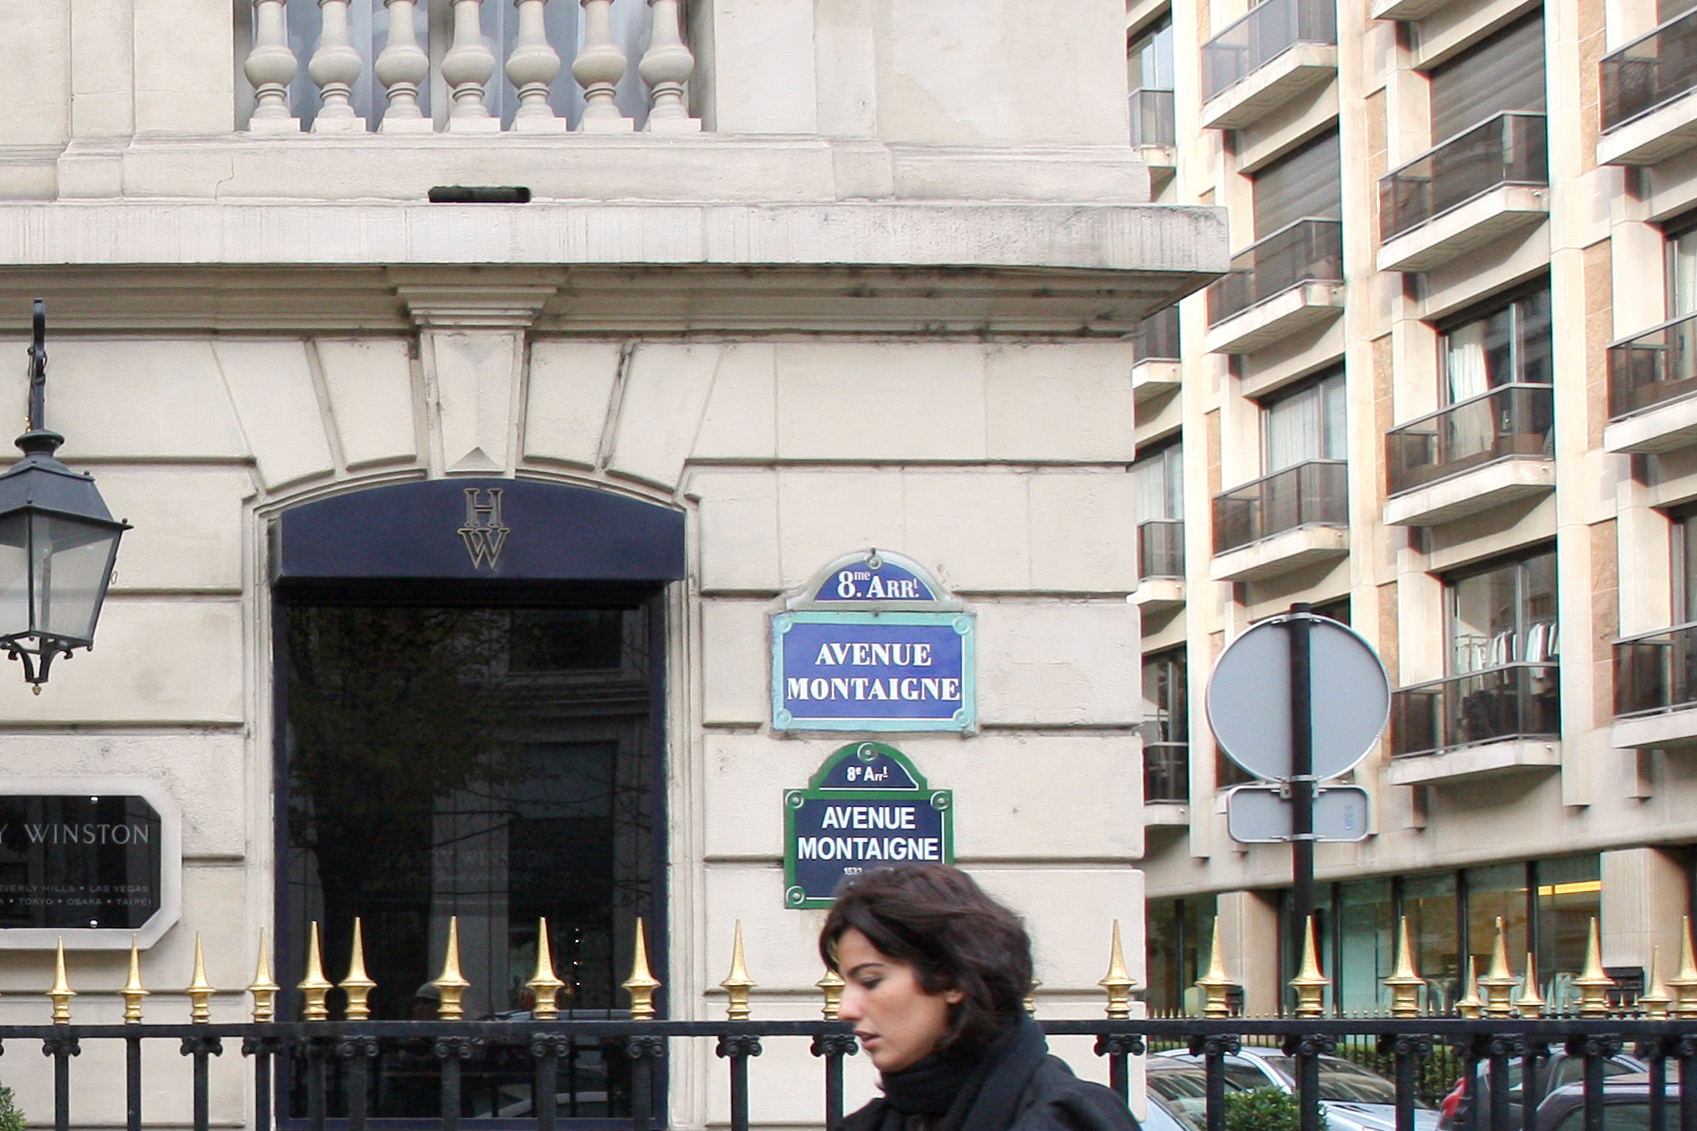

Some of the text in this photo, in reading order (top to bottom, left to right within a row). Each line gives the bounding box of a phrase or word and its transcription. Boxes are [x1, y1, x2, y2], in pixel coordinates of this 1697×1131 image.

[463, 488, 503, 528] H
[457, 527, 510, 570] W
[815, 643, 932, 666] AVENUE
[787, 678, 960, 701] MONTAIGNE
[847, 766, 862, 781] 8e
[821, 806, 916, 829] AVENUE
[23, 823, 150, 844] WINSTON
[798, 837, 939, 860] MONTAIGNE
[43, 884, 76, 893] HILLS
[89, 885, 111, 893] LAS
[114, 884, 150, 893] VEGAS
[18, 897, 53, 905] TOKYO
[67, 897, 102, 905] OSAKA
[116, 898, 152, 906] TAIPEI
